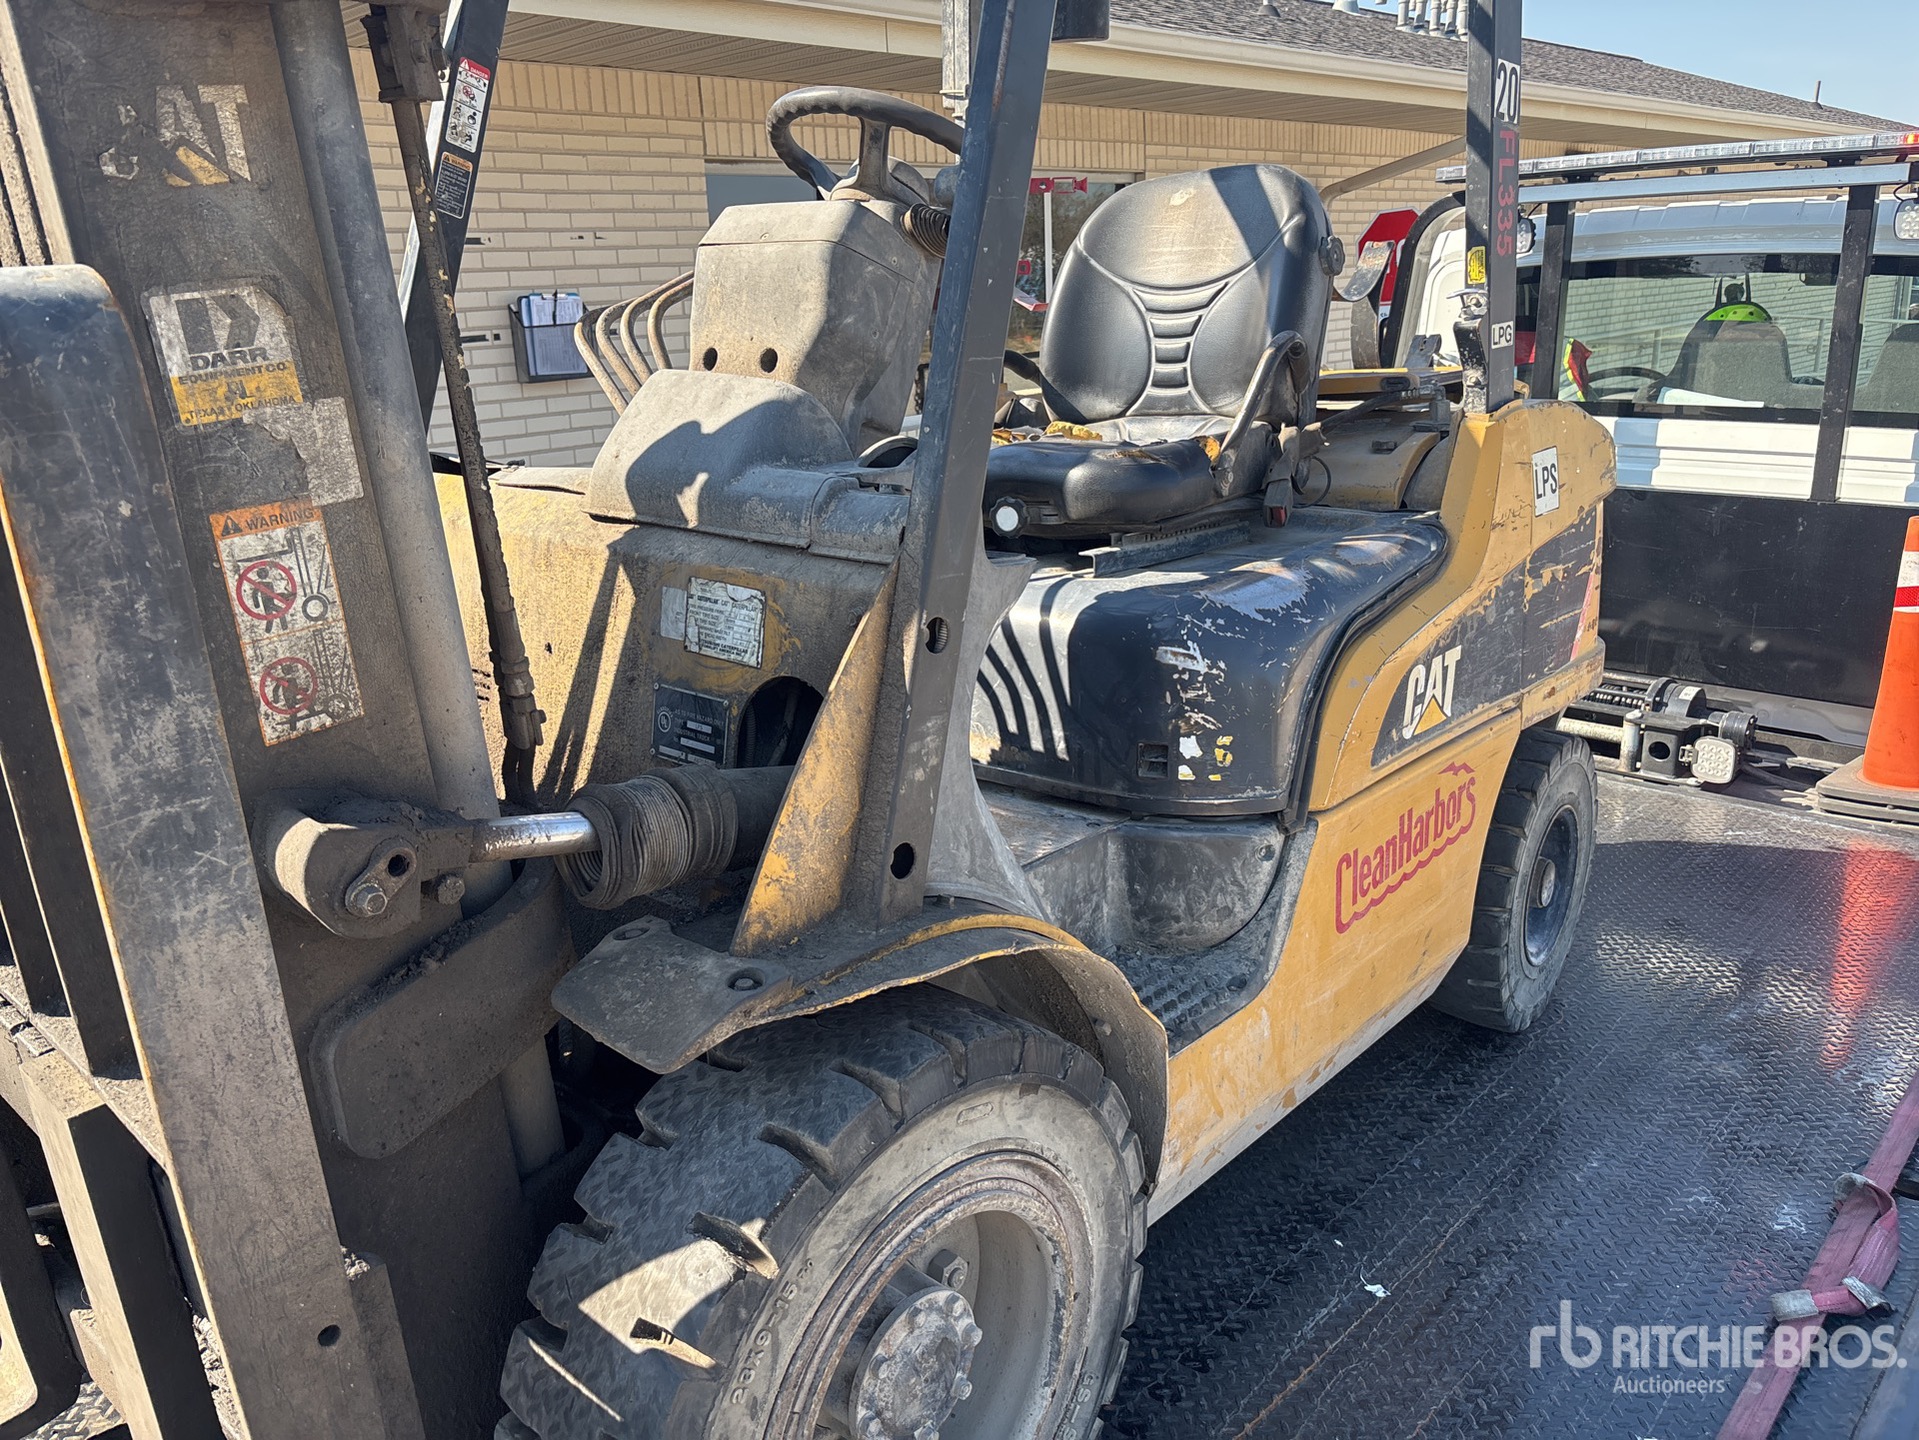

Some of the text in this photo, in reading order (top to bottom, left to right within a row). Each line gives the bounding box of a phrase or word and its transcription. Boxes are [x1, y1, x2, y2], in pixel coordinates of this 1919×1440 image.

[1497, 62, 1519, 122] 20
[1496, 129, 1516, 257] FL335
[1492, 325, 1513, 347] LPG
[189, 347, 269, 372] DARR
[178, 366, 264, 386] EQUIPMENT
[234, 396, 296, 412] OKLAHOMA
[1534, 463, 1558, 500] LPS
[246, 507, 315, 531] WARNING
[1402, 645, 1462, 740] CAT
[1336, 776, 1476, 935] CleanHarbors
